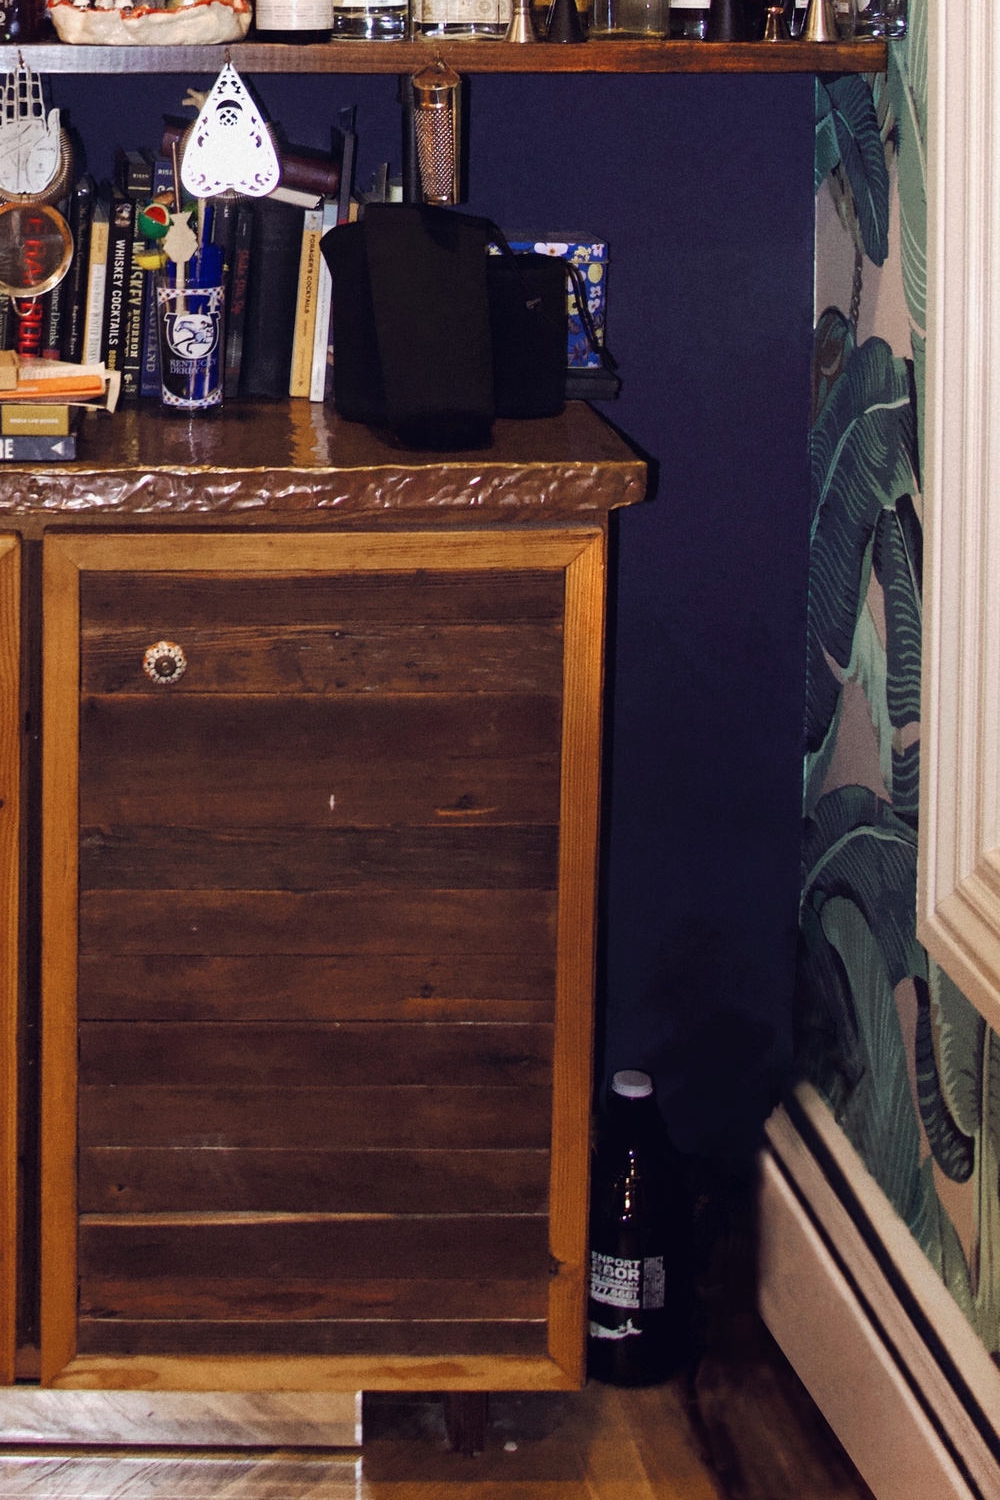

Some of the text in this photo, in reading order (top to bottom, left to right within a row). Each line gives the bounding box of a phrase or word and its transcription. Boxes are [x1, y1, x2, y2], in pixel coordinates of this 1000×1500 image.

[304, 233, 317, 314] FORAGER'S COCKTAILS
[109, 240, 126, 346] WHISKEY COCKTAILS
[49, 312, 61, 347] Drinks
[130, 308, 141, 358] BOURBON
[169, 358, 218, 368] KENTUCKY
[169, 366, 200, 375] DERBY
[592, 1251, 641, 1270] ENPORT
